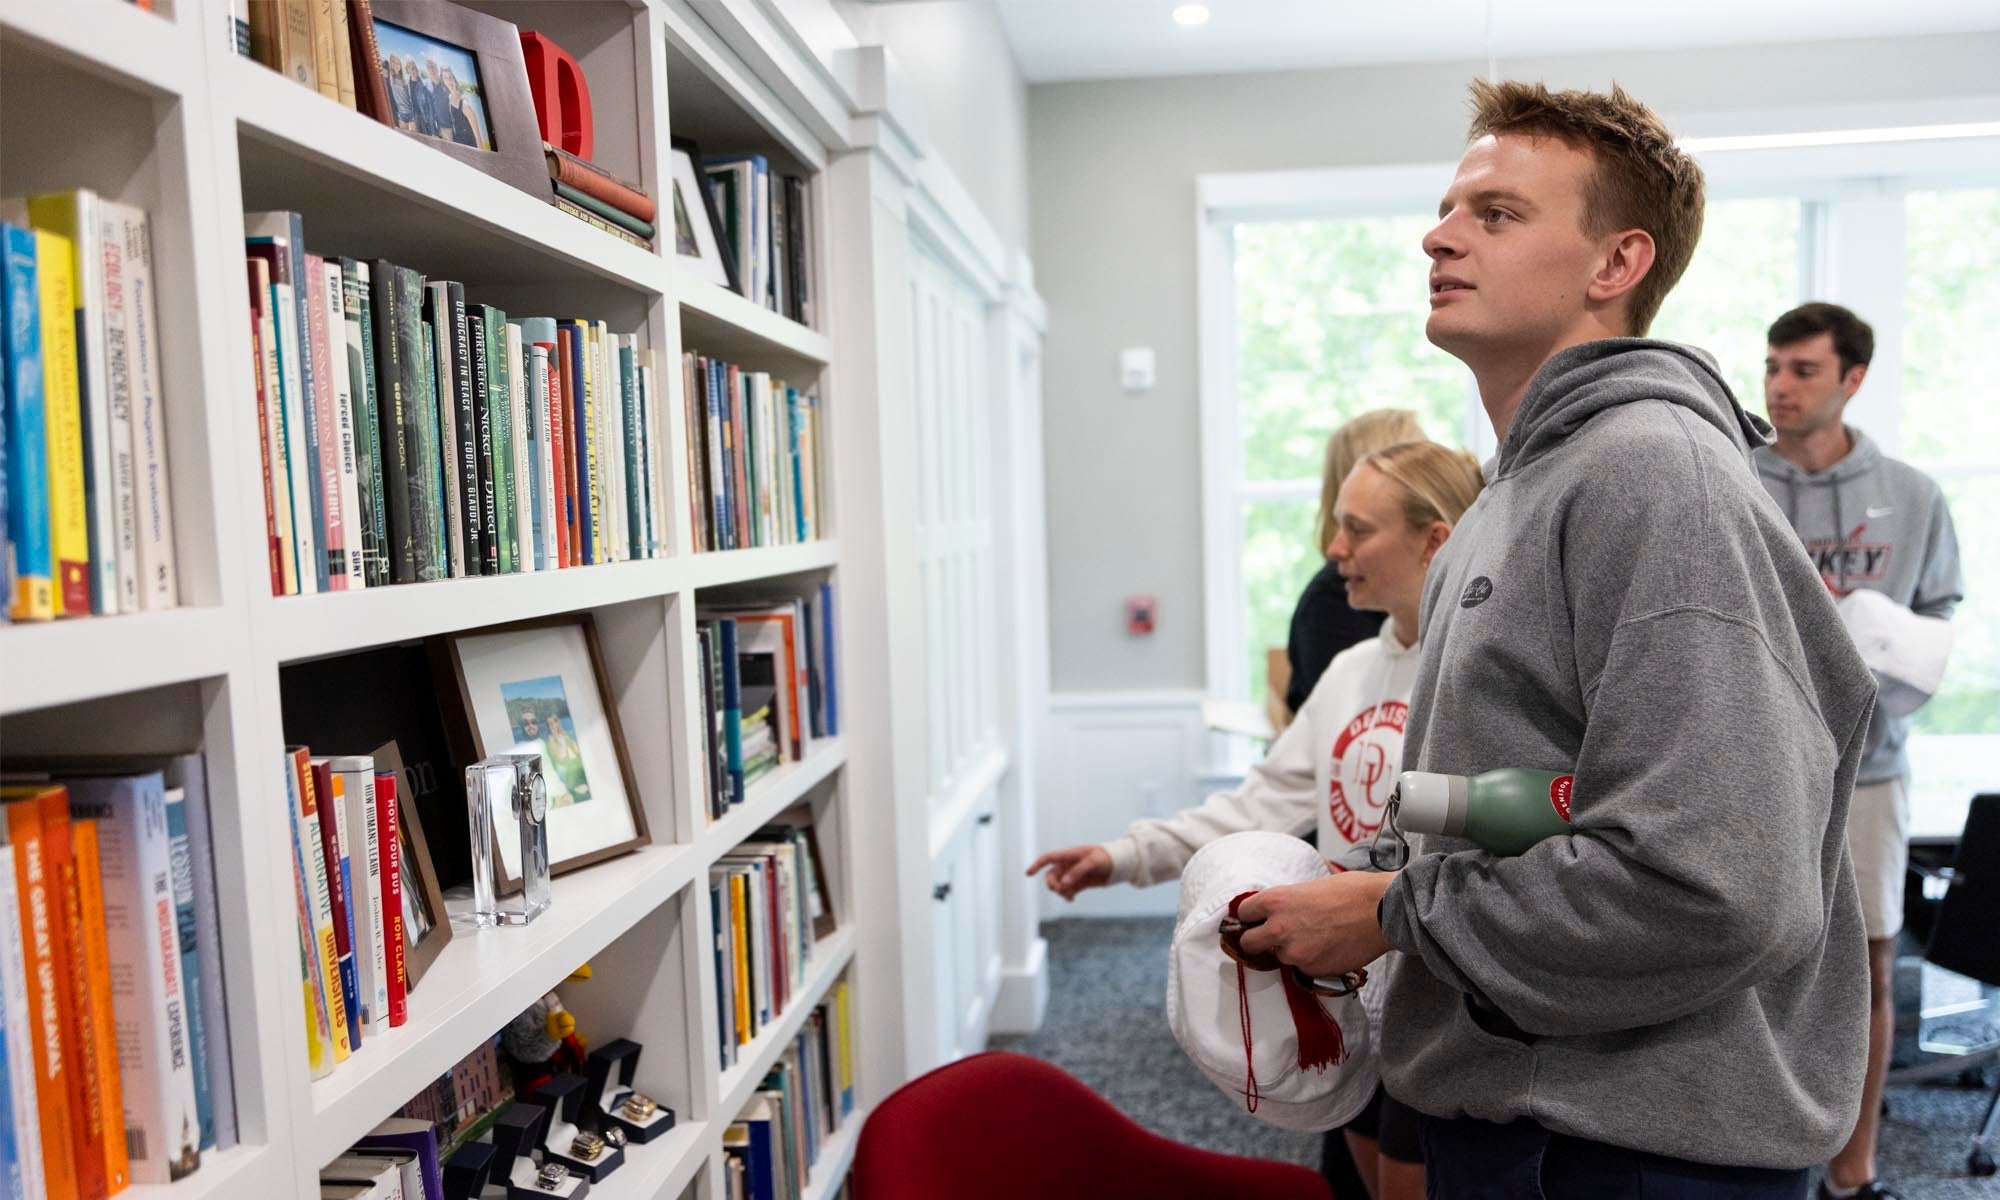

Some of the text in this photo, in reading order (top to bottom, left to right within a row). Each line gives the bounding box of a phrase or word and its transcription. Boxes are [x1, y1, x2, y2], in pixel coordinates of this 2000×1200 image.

[102, 241, 126, 313] ECOLOGY
[268, 349, 279, 376] WHY
[302, 298, 315, 380] Democracy's
[309, 382, 320, 447] Education
[497, 325, 508, 375] WITH
[109, 327, 129, 422] DEMOCRACY
[523, 371, 531, 404] Affluent
[541, 368, 549, 385] HOW
[134, 278, 149, 375] Foundations
[148, 462, 161, 543] Evaluation
[340, 393, 350, 429] Forced
[362, 308, 385, 540] Understanding Local Economic Development
[394, 382, 403, 425] GOING
[455, 300, 479, 545] DEMOCRACY IN BLACK EDDIE S. GLAUDE JR.
[525, 407, 533, 434] Society
[542, 386, 550, 418] HUMANS
[551, 376, 562, 446] WORTH IT?
[625, 375, 637, 446] AUTHORITY
[397, 430, 406, 470] LOCAL
[474, 324, 486, 399] EHRENREICH
[485, 480, 497, 534] Dimed
[543, 419, 551, 443] LEARN
[118, 453, 131, 489] DAVID
[343, 432, 354, 475] Choices
[325, 466, 341, 528] AMERICA
[351, 549, 363, 578] SUNY
[364, 783, 374, 804] HOW
[366, 806, 377, 847] HUMANS
[369, 848, 379, 878] LEARN
[302, 762, 346, 1029] STALEY ALTERNATIVE UNIVERSITIES
[372, 896, 381, 930] Joshua
[388, 799, 405, 984] MOVE YOUR BUS RON CLARK
[176, 906, 199, 955] PLAN
[26, 839, 62, 1080] THE GREAT UPHEAVAL
[154, 871, 186, 1071] THE UNDERGRADUATE EXPERIENCE
[375, 946, 384, 972] Eyler
[81, 1015, 102, 1136] EDUCATION
